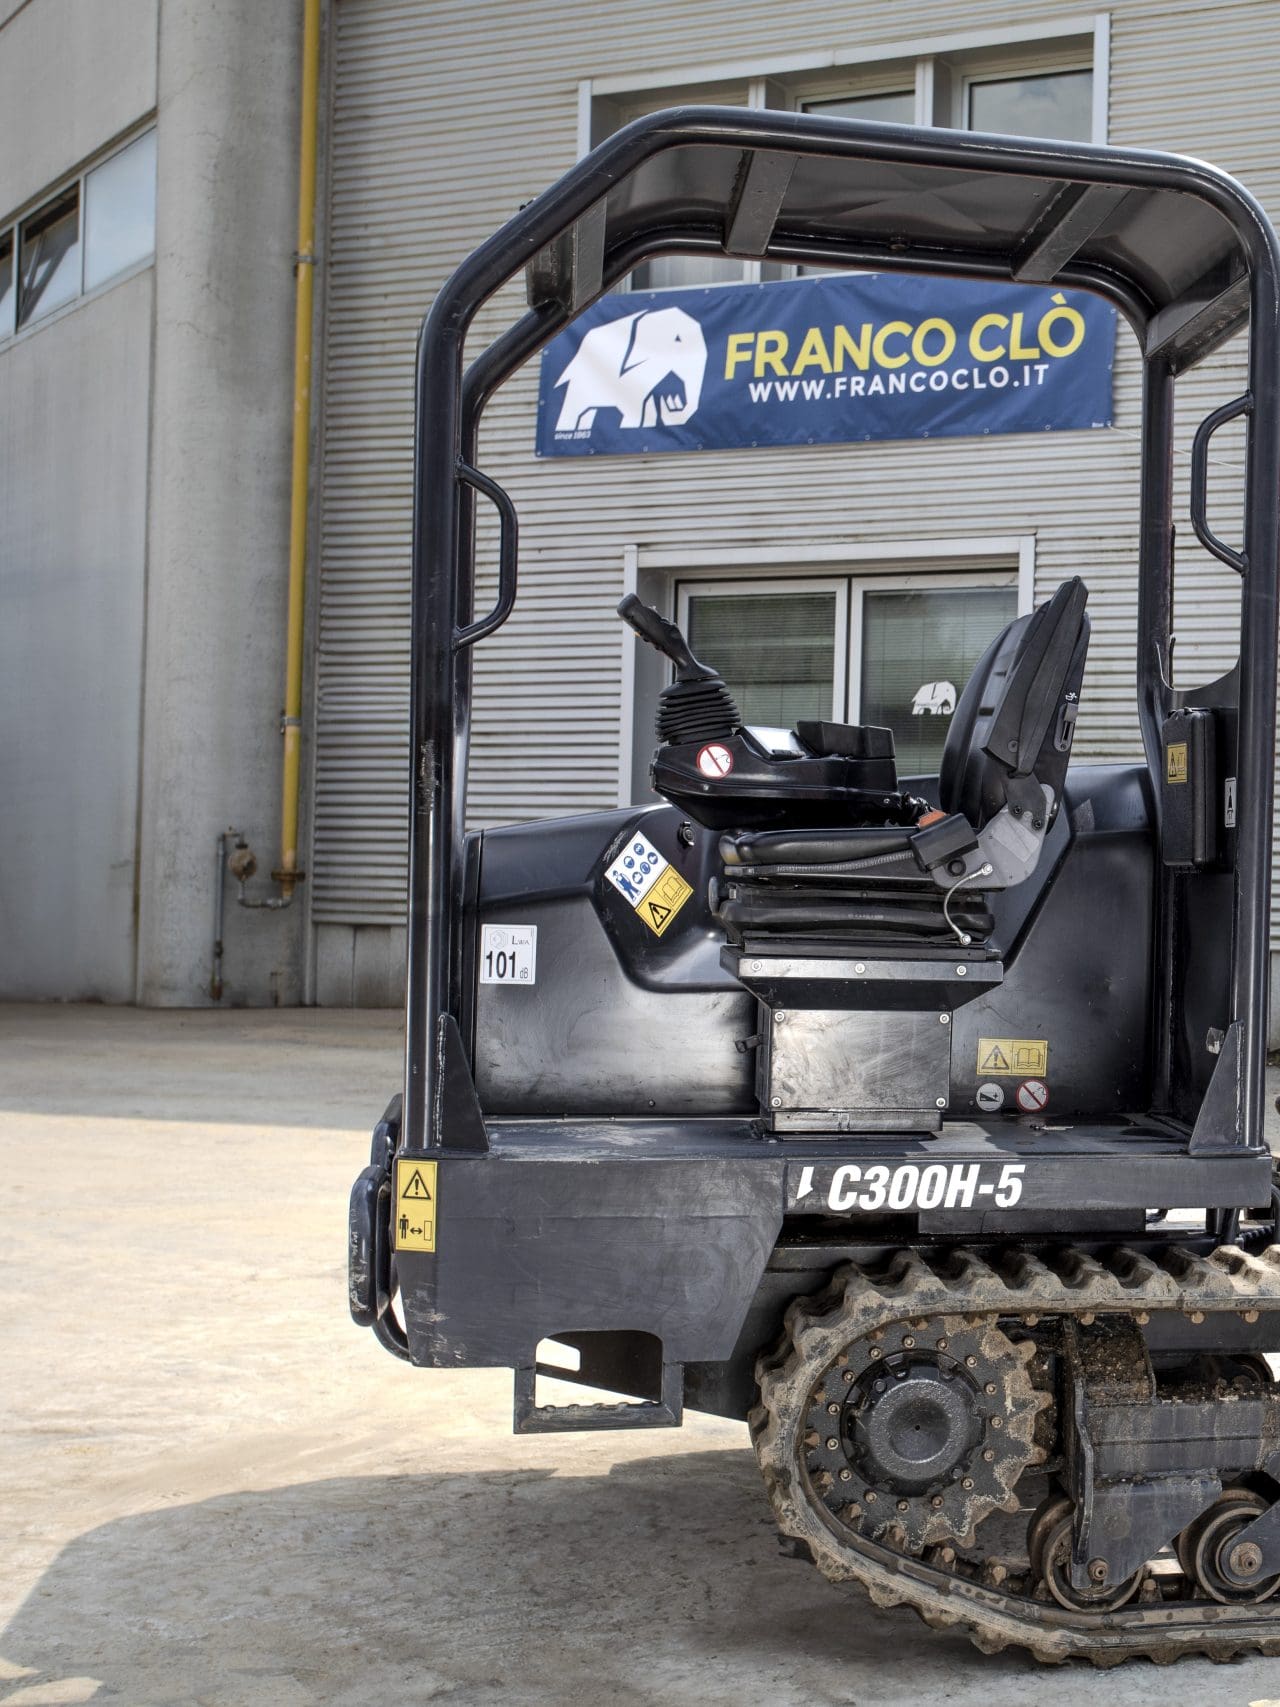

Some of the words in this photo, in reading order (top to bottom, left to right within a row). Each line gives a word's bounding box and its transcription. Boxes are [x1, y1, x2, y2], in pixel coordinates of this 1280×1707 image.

[725, 317, 957, 380] FRANCO
[968, 292, 1086, 363] CLÒ
[747, 363, 1050, 404] WWW.FRANCOCLO.IT
[485, 950, 516, 979] 101
[519, 967, 529, 979] dB
